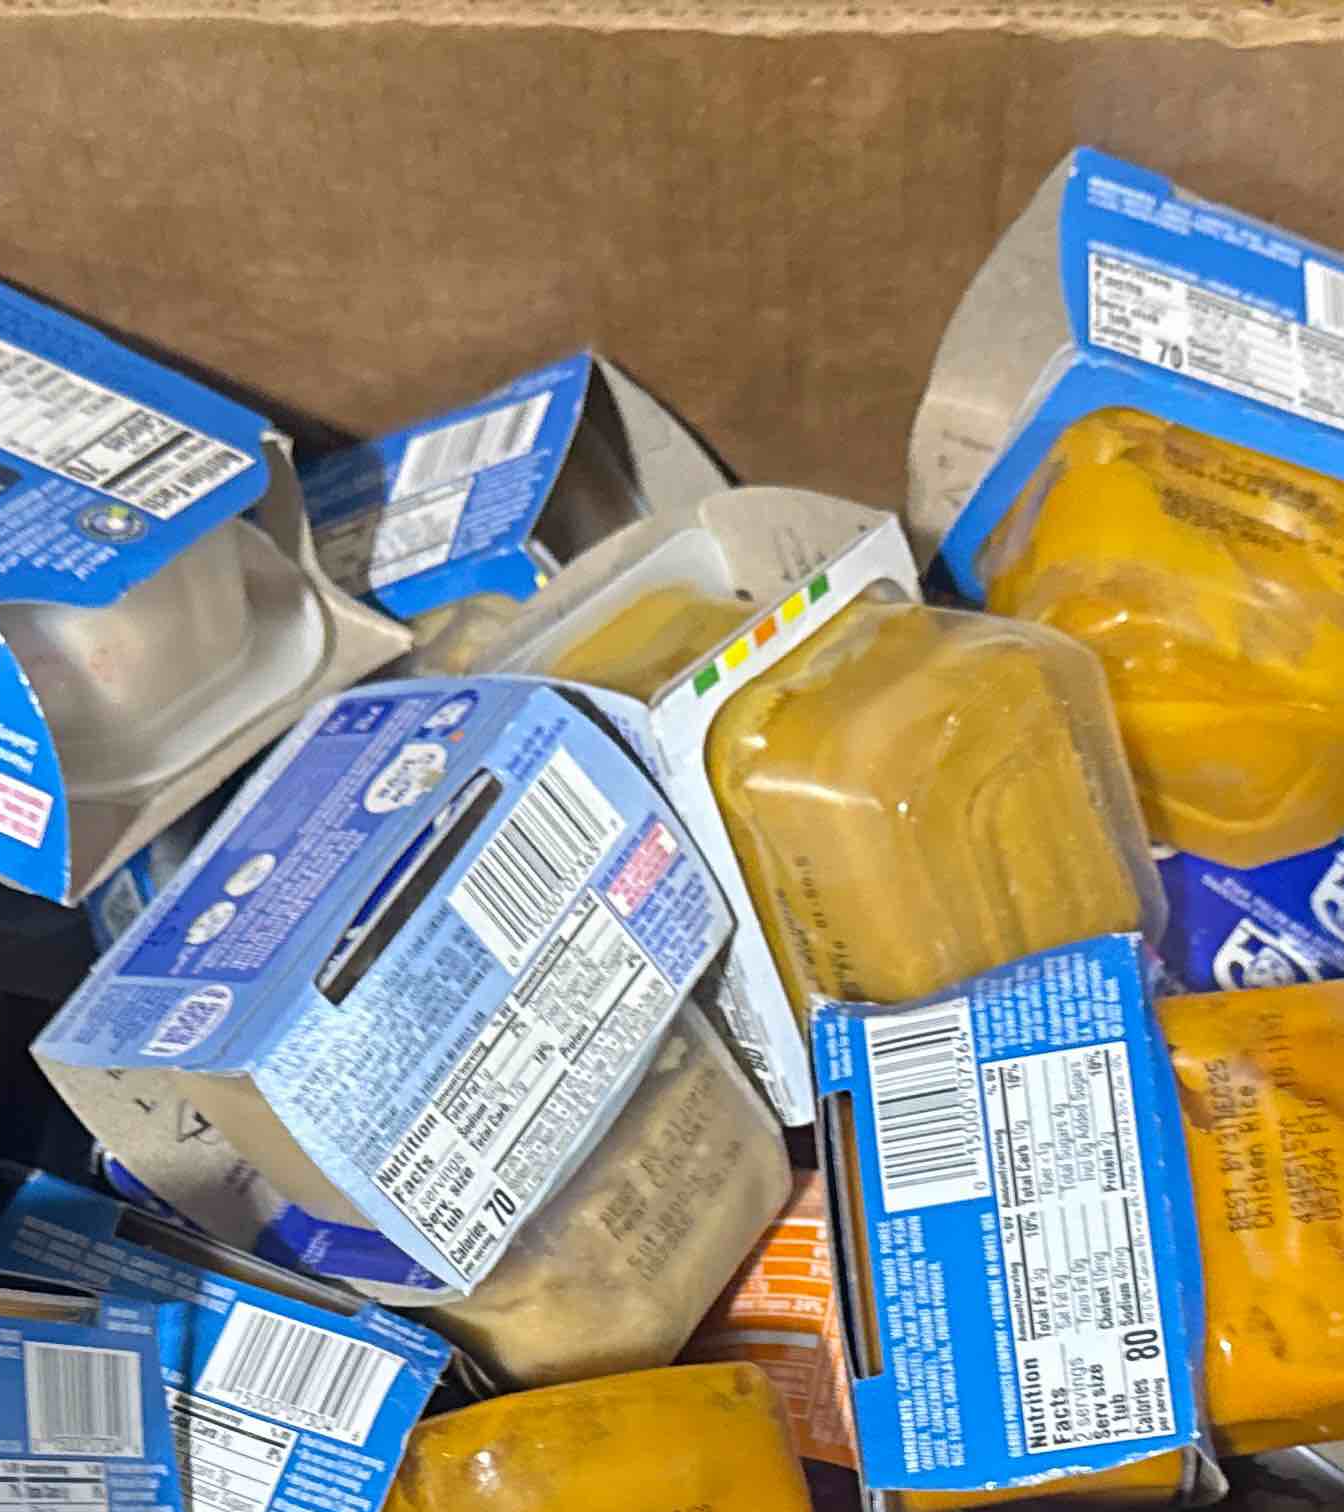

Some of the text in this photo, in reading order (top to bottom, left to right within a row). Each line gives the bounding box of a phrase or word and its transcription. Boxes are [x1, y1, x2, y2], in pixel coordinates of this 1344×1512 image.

[1156, 341, 1183, 368] 70
[953, 1031, 974, 1089] 07364
[375, 1109, 439, 1189] Nutrition
[960, 1097, 982, 1153] 15000
[1236, 1084, 1274, 1229] Chicken Rice
[391, 1151, 436, 1205] Facts
[446, 1163, 476, 1197] size
[447, 1186, 517, 1265] Calories 70
[1022, 1357, 1048, 1448] Nutrition
[1086, 1363, 1111, 1439] Serv size
[1125, 1325, 1159, 1435] Calories 80
[1049, 1386, 1072, 1444] Facts
